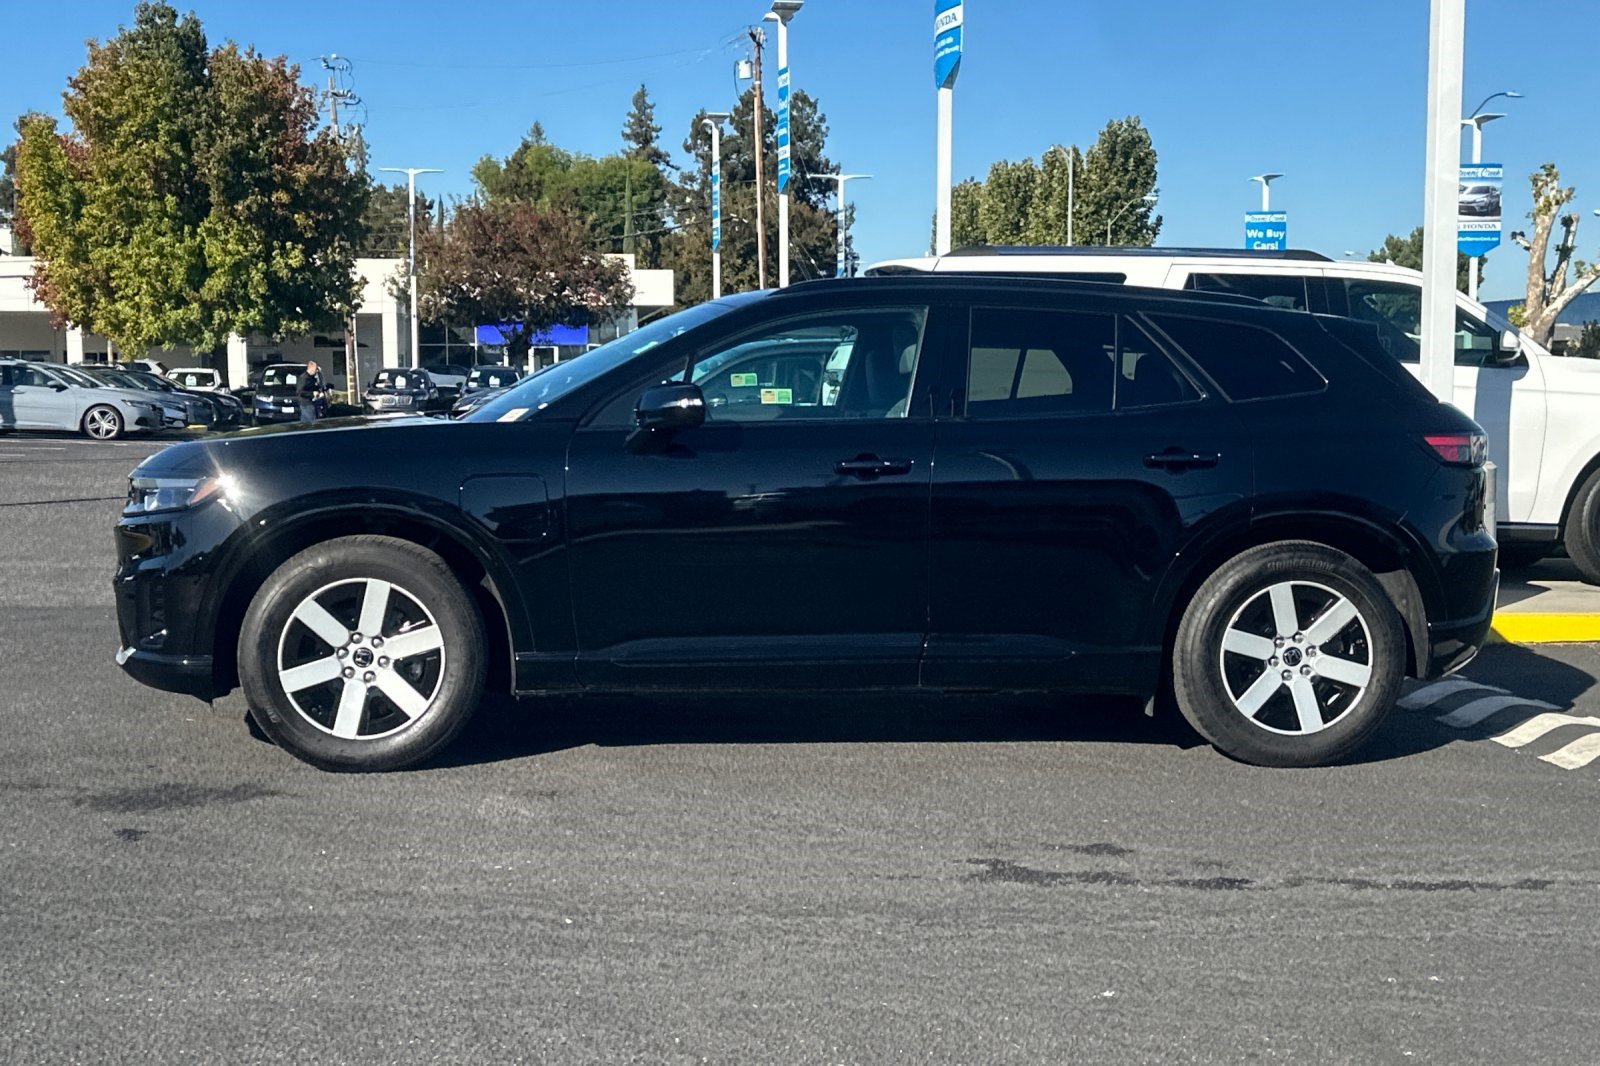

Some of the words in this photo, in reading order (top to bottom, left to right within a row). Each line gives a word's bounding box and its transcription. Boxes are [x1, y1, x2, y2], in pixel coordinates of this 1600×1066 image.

[936, 12, 958, 31] ONDA
[1246, 229, 1264, 239] We
[1266, 229, 1285, 241] Buy
